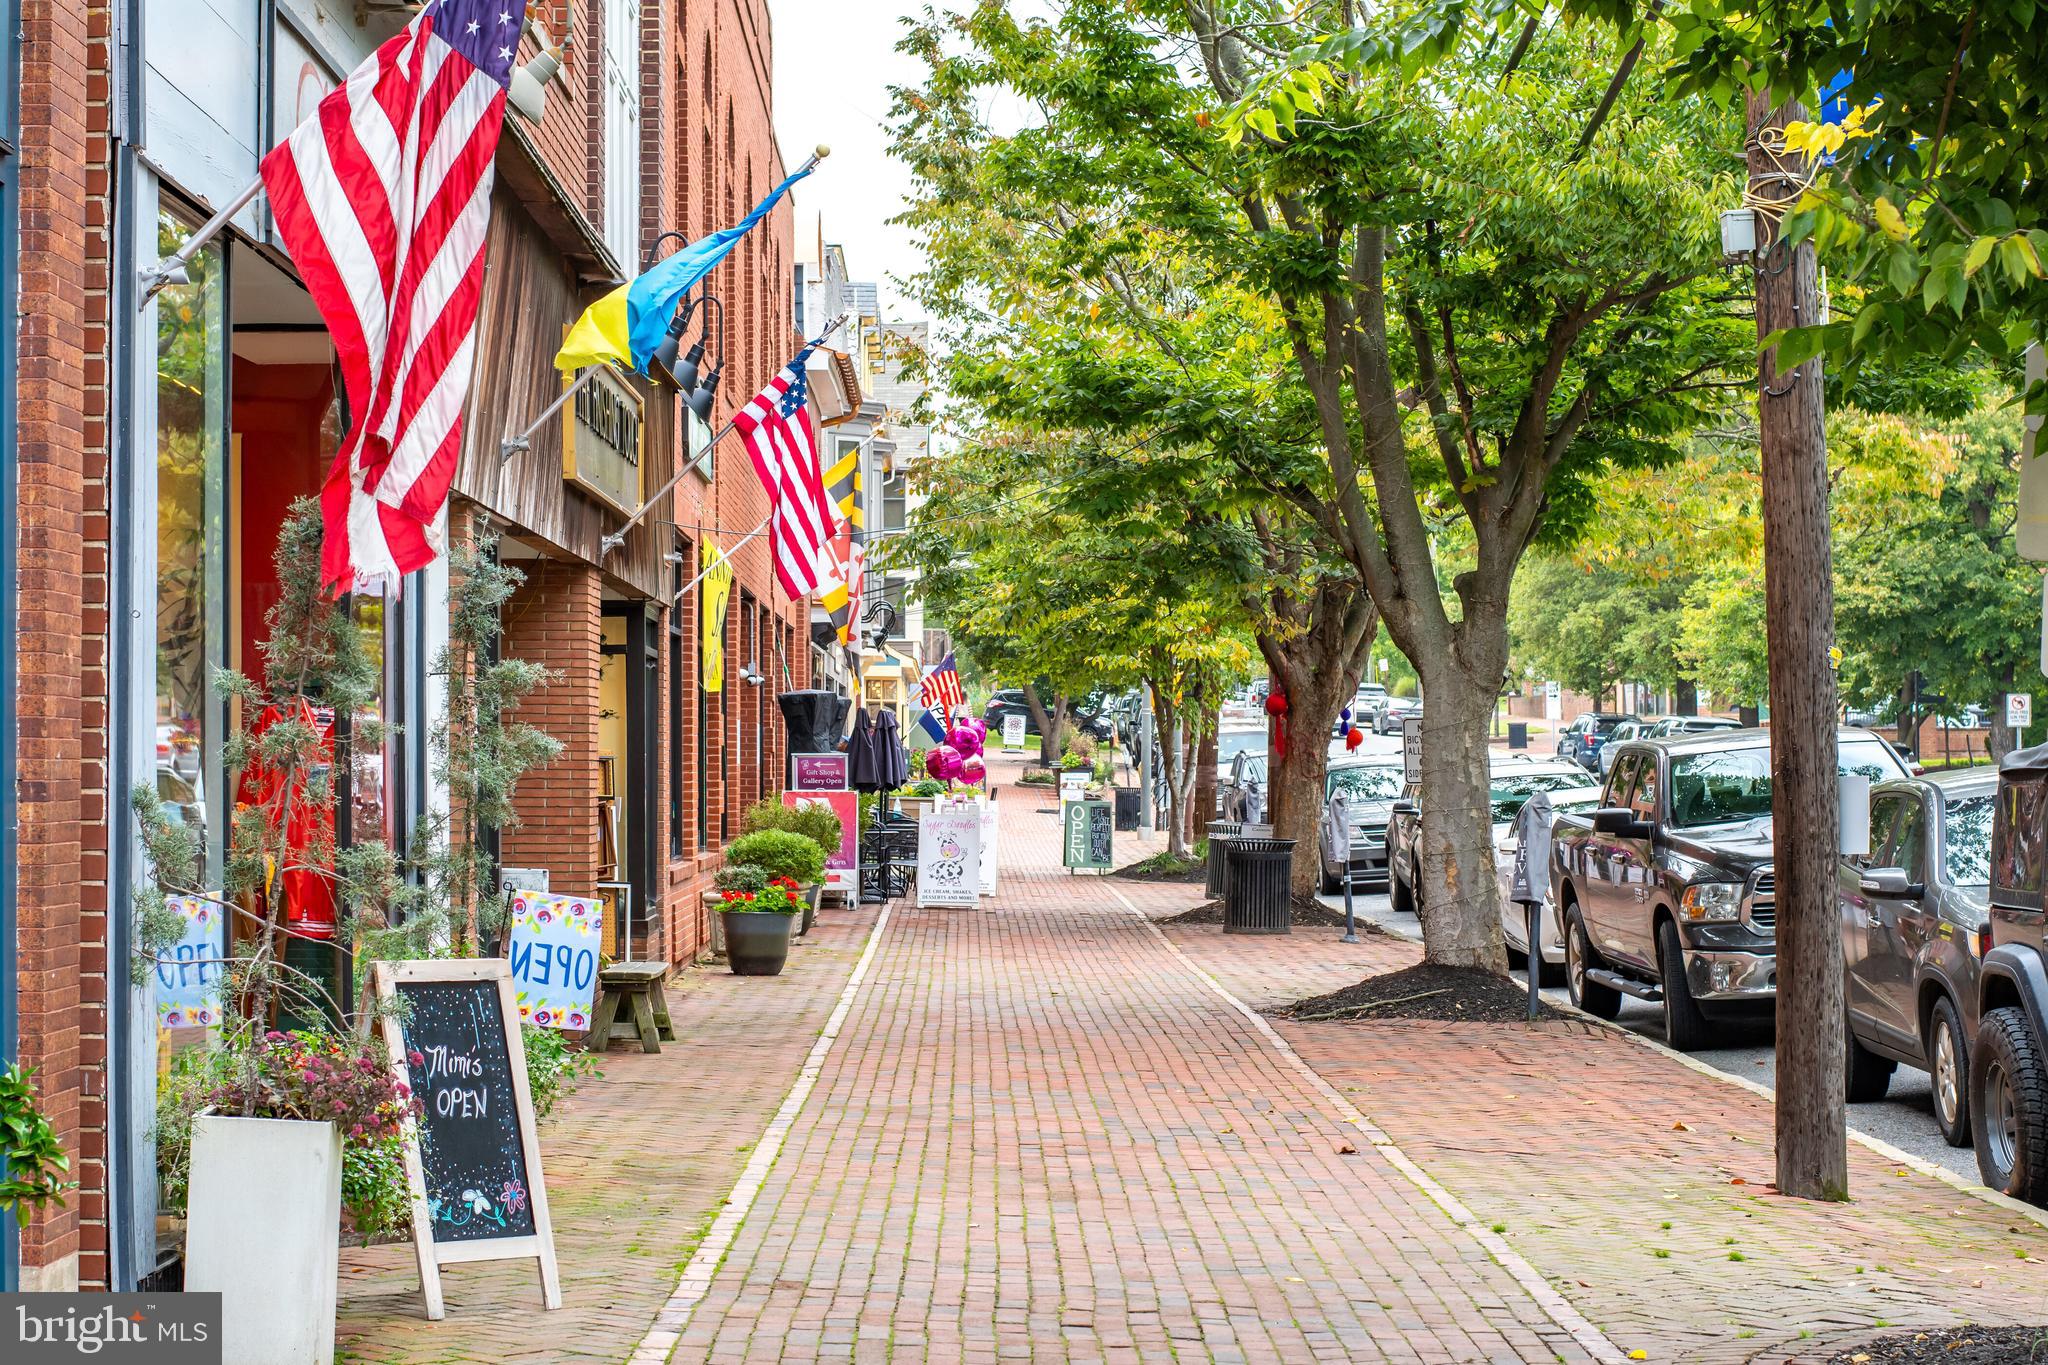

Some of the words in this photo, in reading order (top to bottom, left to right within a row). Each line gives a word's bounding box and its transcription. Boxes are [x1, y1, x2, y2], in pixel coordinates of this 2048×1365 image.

[819, 769, 834, 777] Shop
[1091, 808, 1105, 817] LIFE
[1071, 805, 1085, 863] OPEN
[436, 1087, 487, 1119] OPEN
